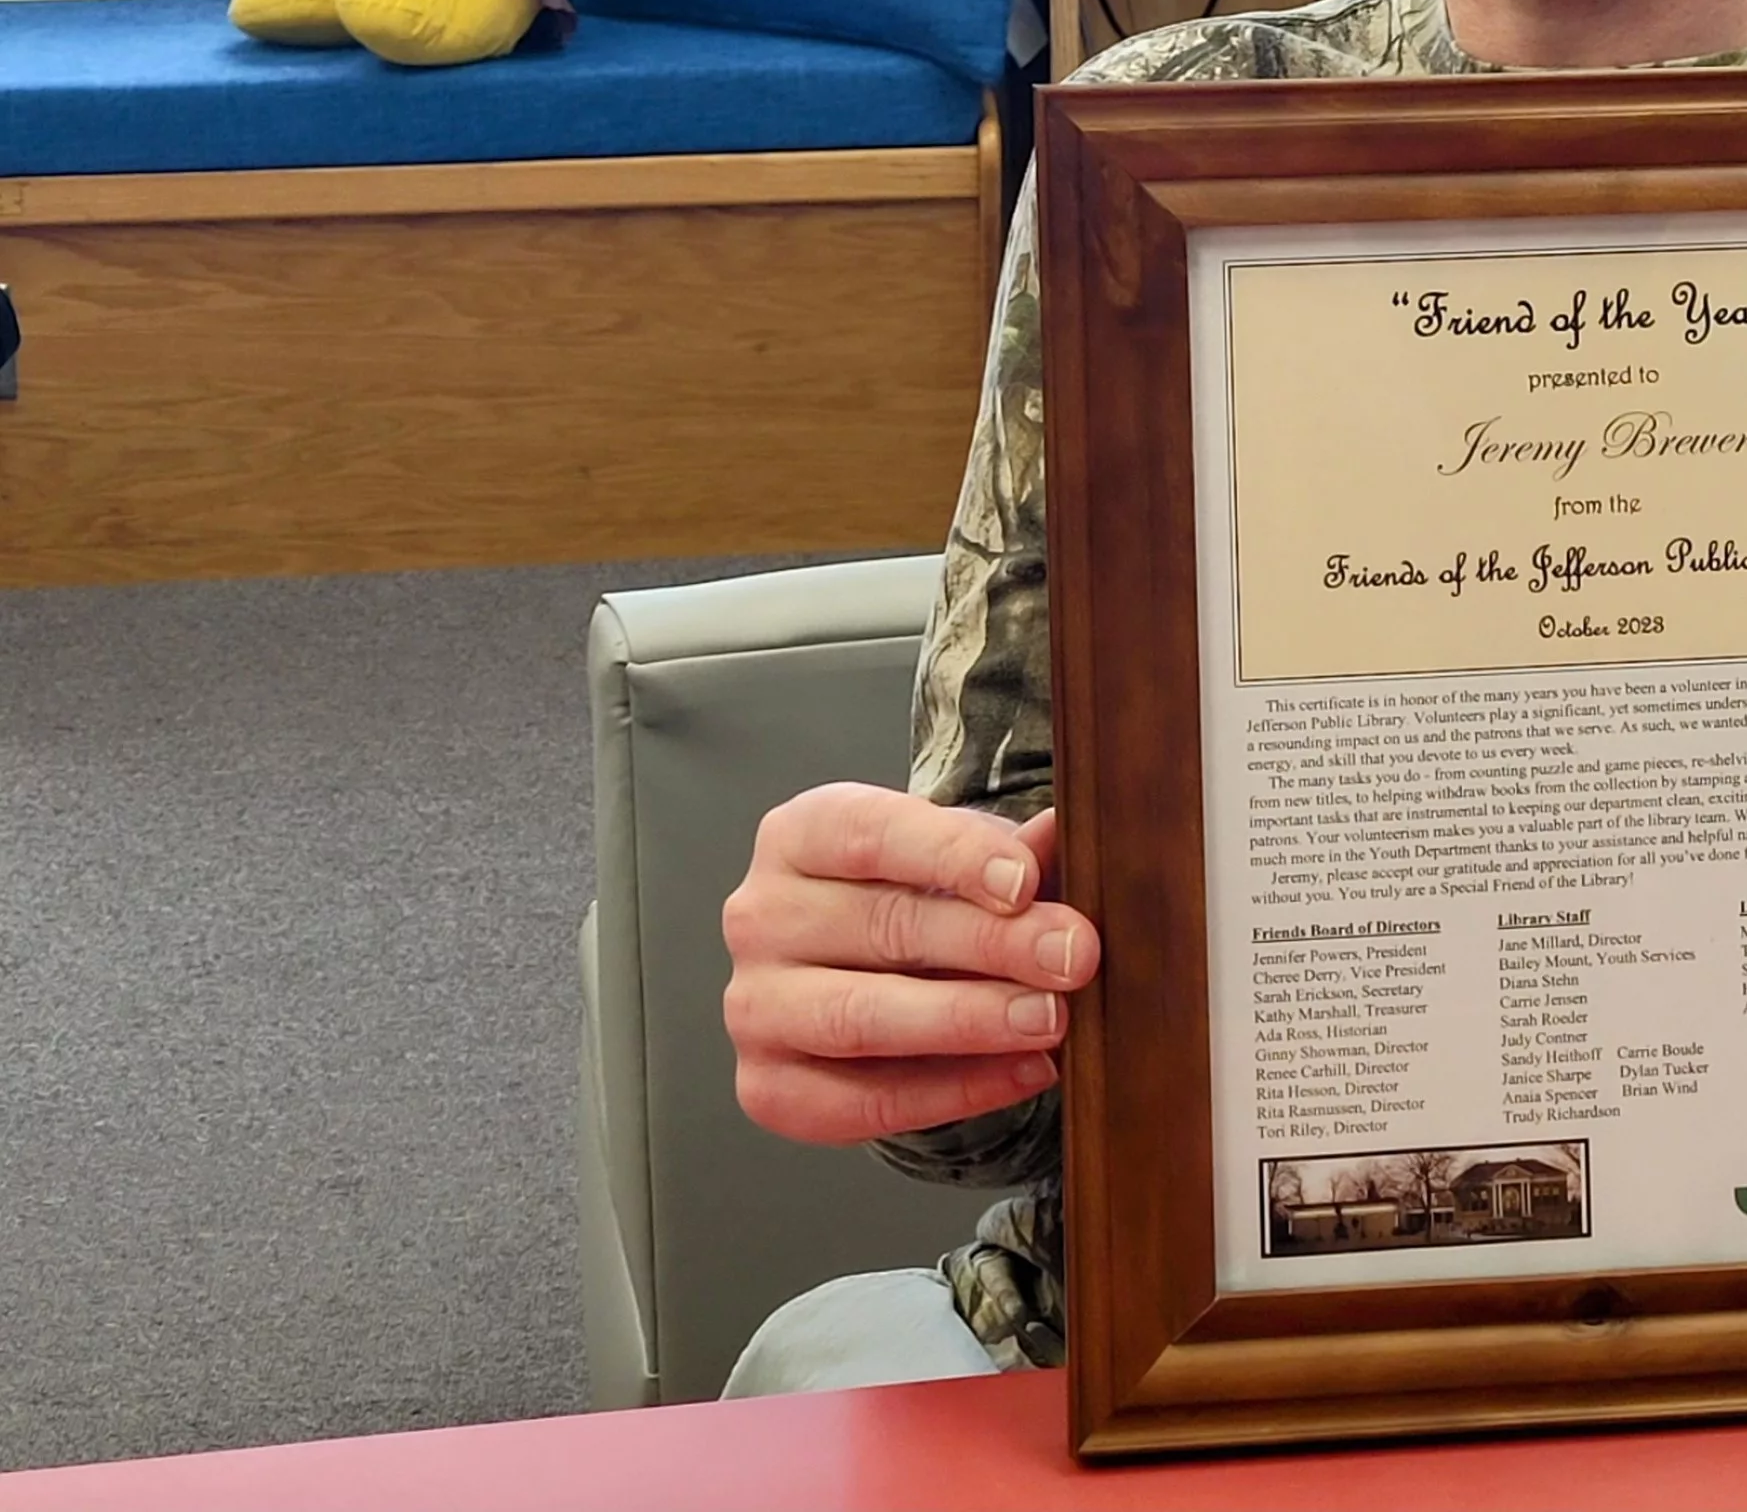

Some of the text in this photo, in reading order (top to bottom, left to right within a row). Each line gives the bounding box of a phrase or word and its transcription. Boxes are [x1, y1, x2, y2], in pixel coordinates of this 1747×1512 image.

[1550, 289, 1588, 349] of
[1597, 288, 1656, 331] the
[1528, 364, 1661, 393] presented to
[1437, 415, 1588, 481] Jeremy
[1552, 492, 1643, 522] from the
[1322, 552, 1428, 590] Friends
[1438, 552, 1468, 597] of
[1476, 551, 1519, 584] the
[1528, 541, 1655, 593] Jefferson
[1538, 614, 1666, 639] October 2023
[1265, 698, 1296, 713] This
[1299, 695, 1365, 712] certificate
[1367, 695, 1380, 709] is
[1383, 694, 1397, 708] in
[1399, 692, 1438, 707] honor
[1441, 690, 1457, 705] of
[1458, 690, 1481, 704] the
[1484, 691, 1520, 706] many
[1524, 690, 1559, 704] years
[1562, 689, 1587, 702] you
[1590, 683, 1622, 697] have
[1624, 682, 1657, 696] been
[1659, 685, 1667, 694] a
[1670, 678, 1732, 693] volunteer
[1252, 919, 1442, 941] Friends Board of Directors
[1498, 908, 1592, 929] Library Staff
